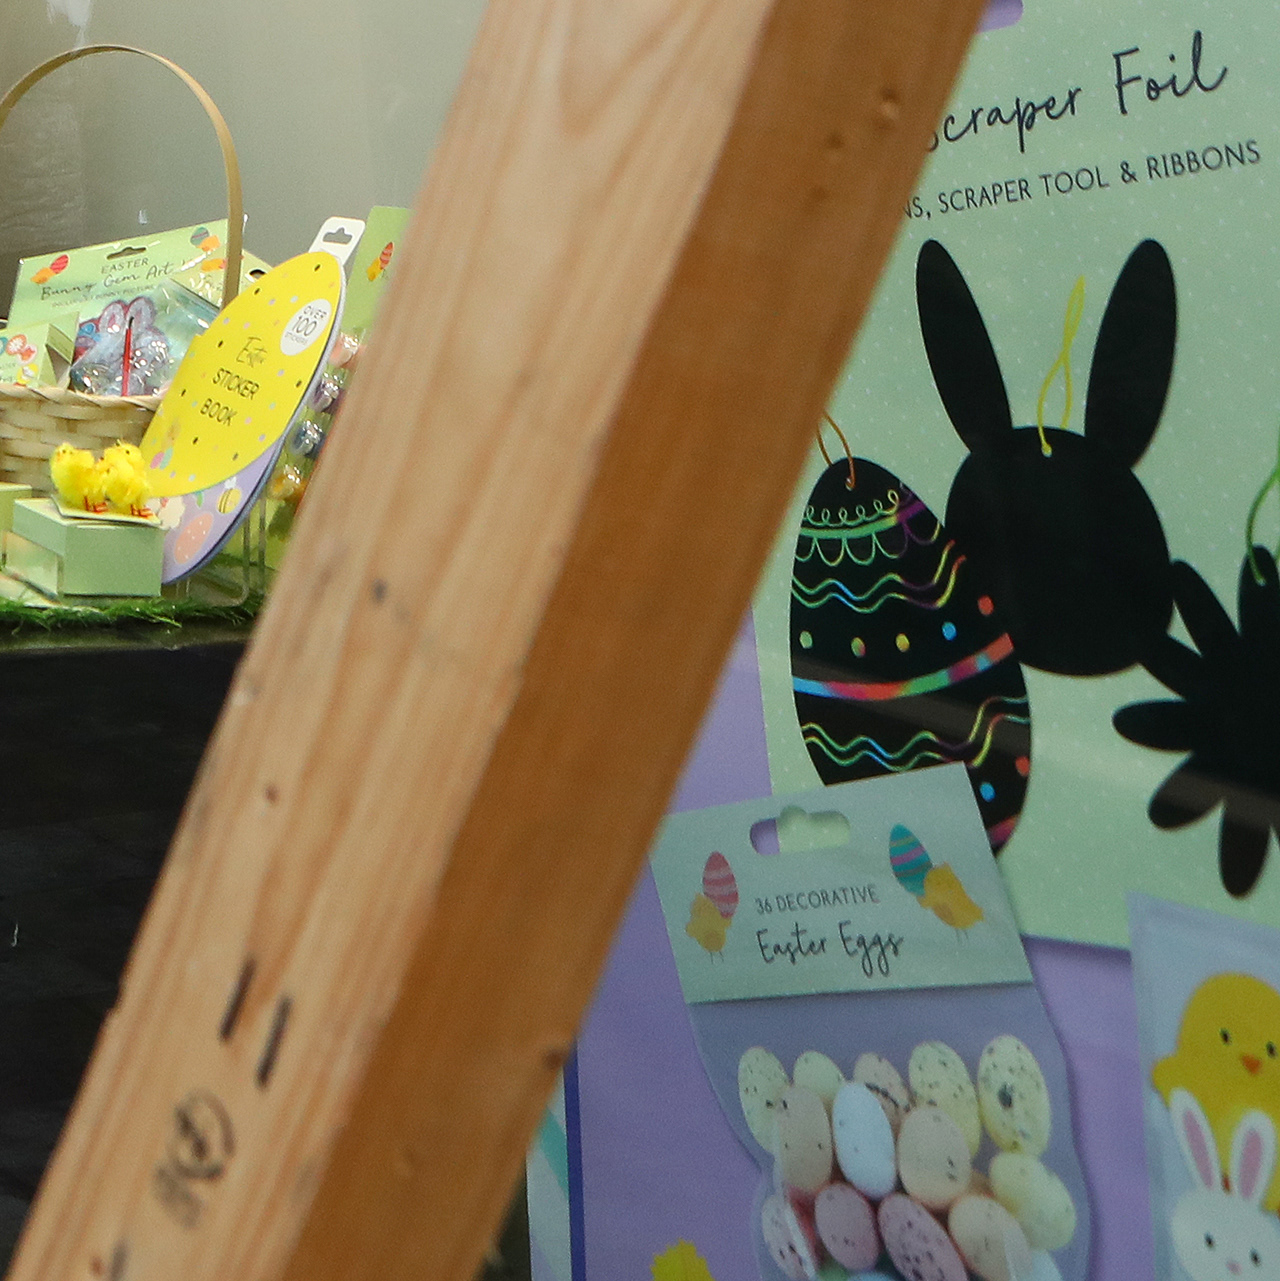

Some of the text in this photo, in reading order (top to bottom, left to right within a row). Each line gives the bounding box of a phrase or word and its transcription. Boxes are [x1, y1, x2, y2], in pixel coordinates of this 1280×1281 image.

[927, 30, 1228, 153] craper Foil
[938, 178, 1032, 215] SCRAPER
[1040, 166, 1110, 199] TOOL
[1120, 160, 1137, 184] &
[1145, 140, 1262, 180] RIBBONS
[100, 257, 150, 276] EASTER
[103, 273, 140, 289] Gem
[145, 261, 175, 281] Art
[291, 316, 317, 337] 100
[302, 305, 328, 320] OVER
[212, 367, 260, 400] STICKER
[200, 398, 239, 427] BOOK
[754, 883, 881, 915] 36 DECORATIVE
[755, 919, 904, 978] Easter Eggs
